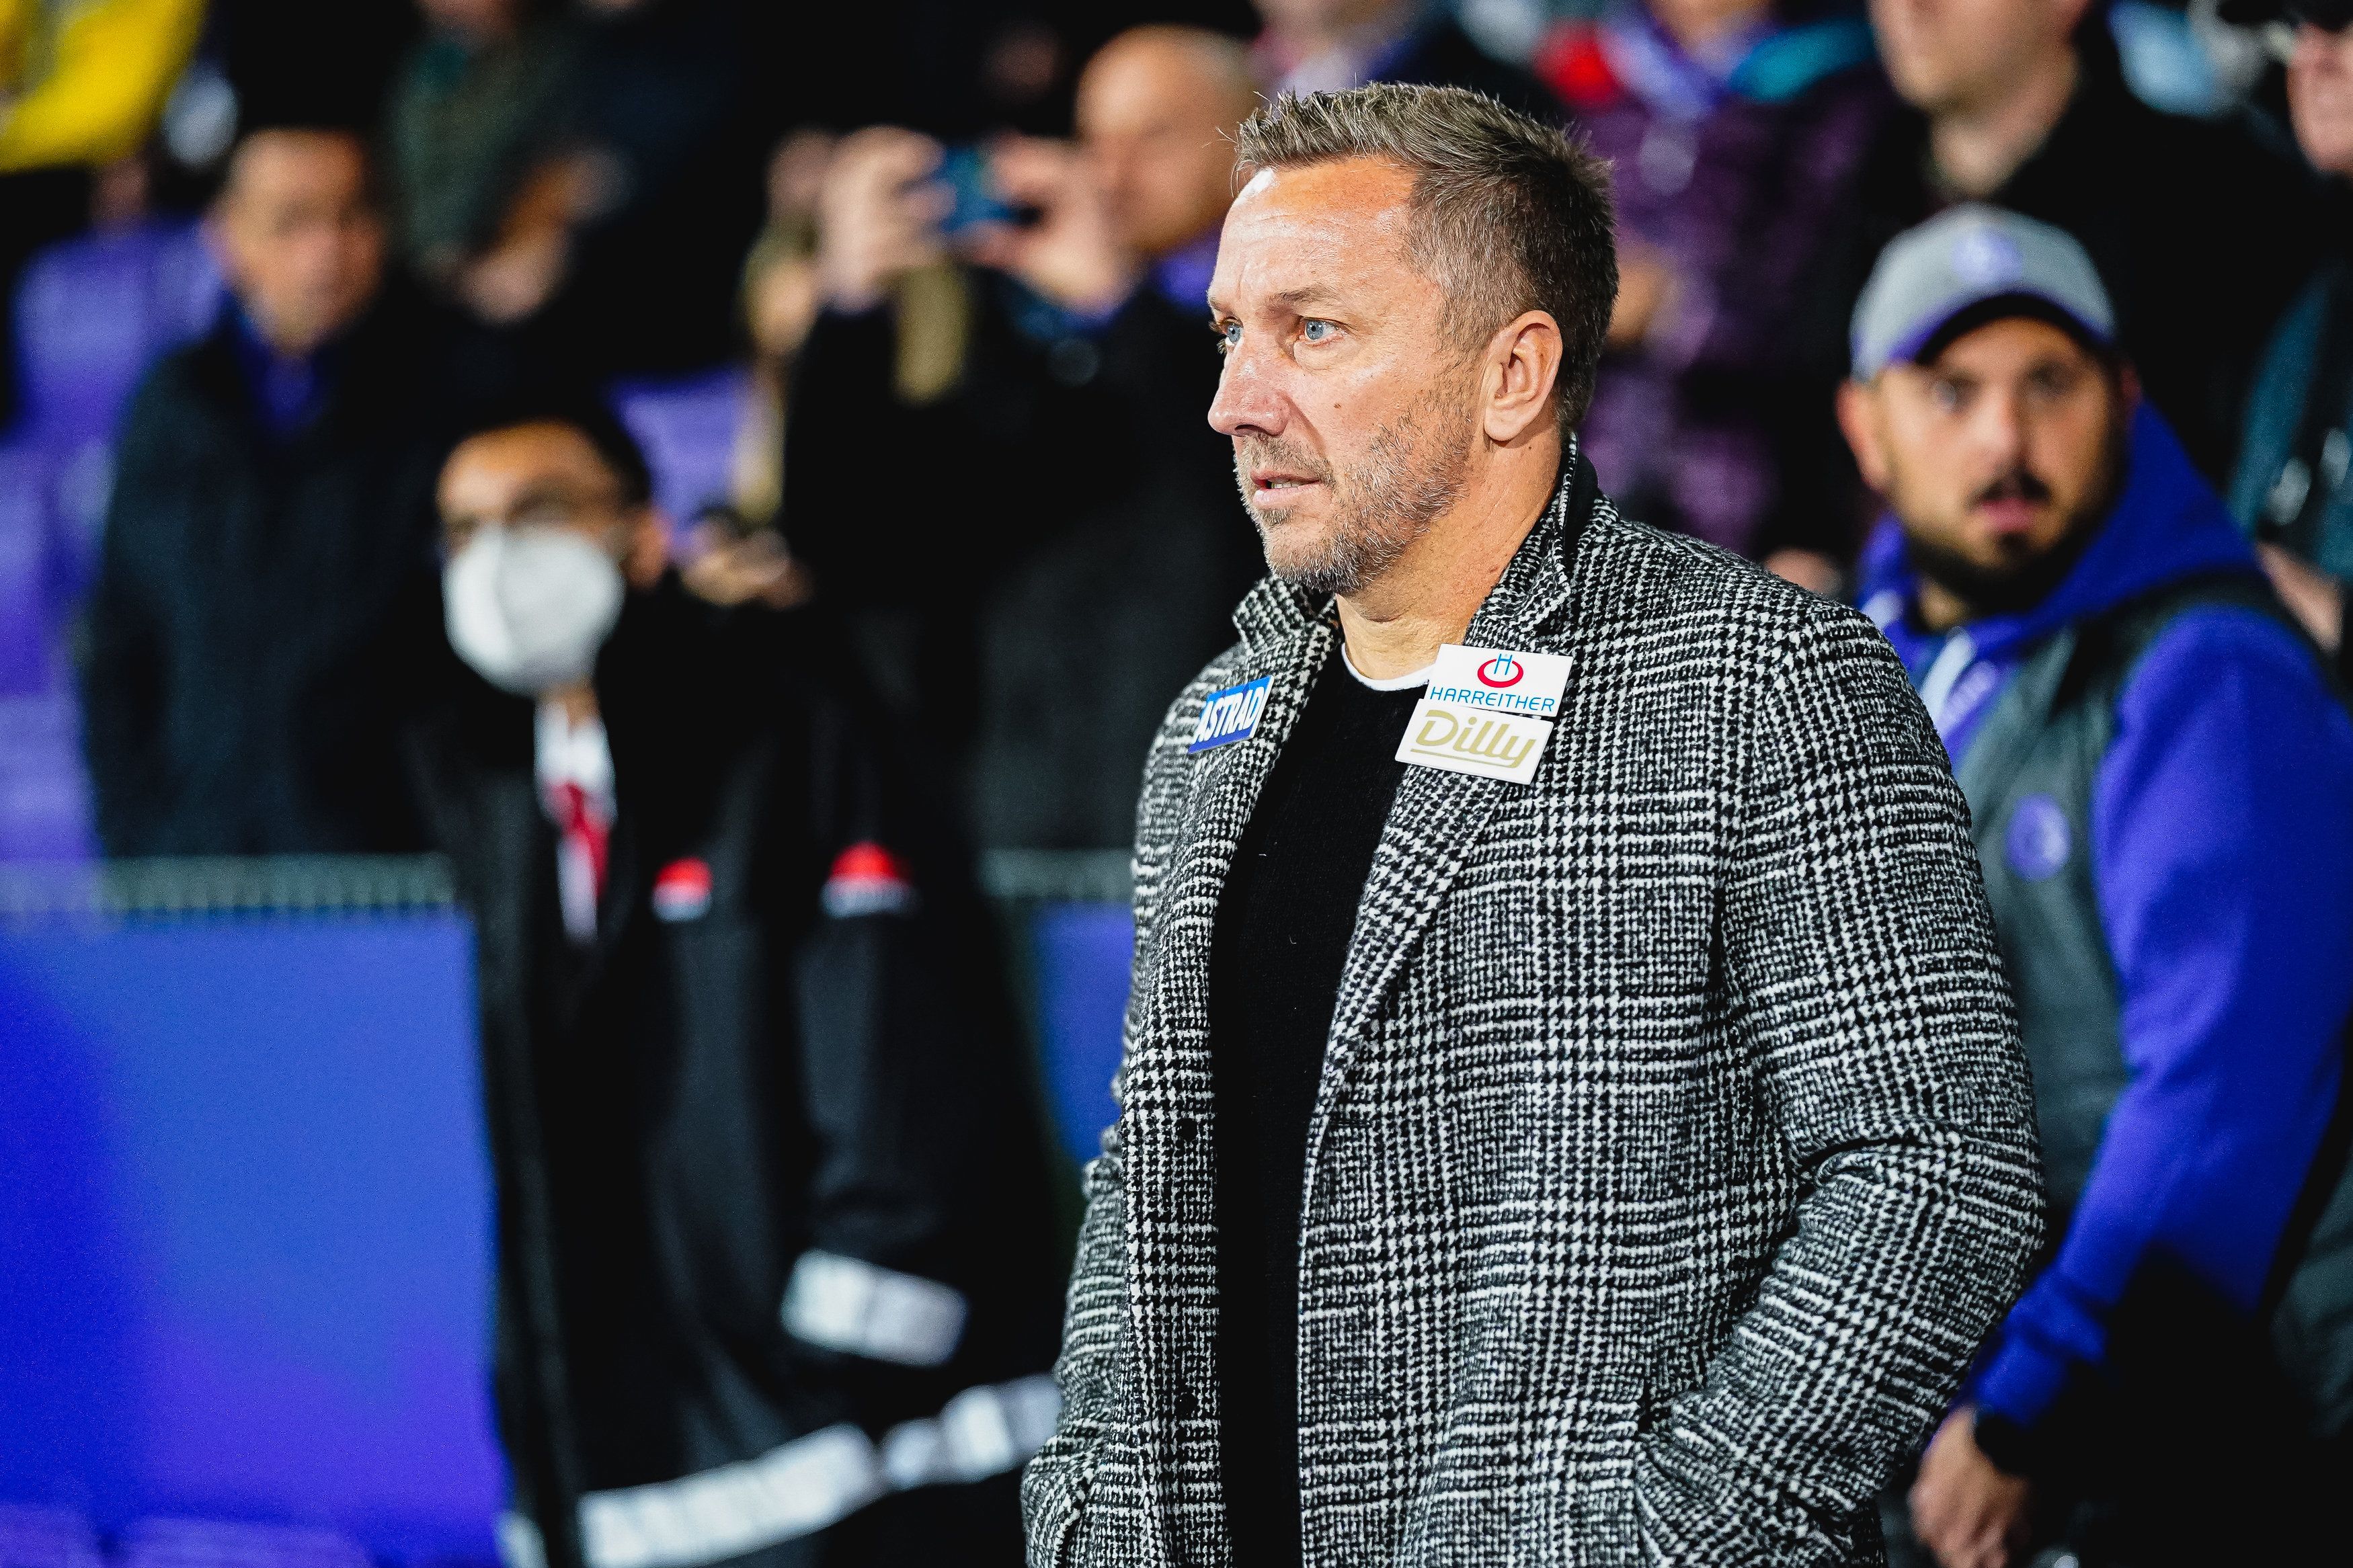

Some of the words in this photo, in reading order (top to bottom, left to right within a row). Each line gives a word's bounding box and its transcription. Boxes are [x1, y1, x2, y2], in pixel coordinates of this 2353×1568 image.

[1192, 686, 1265, 745] ASTRAD
[1430, 686, 1555, 712] HARREITHER
[1415, 710, 1536, 768] Dilly
